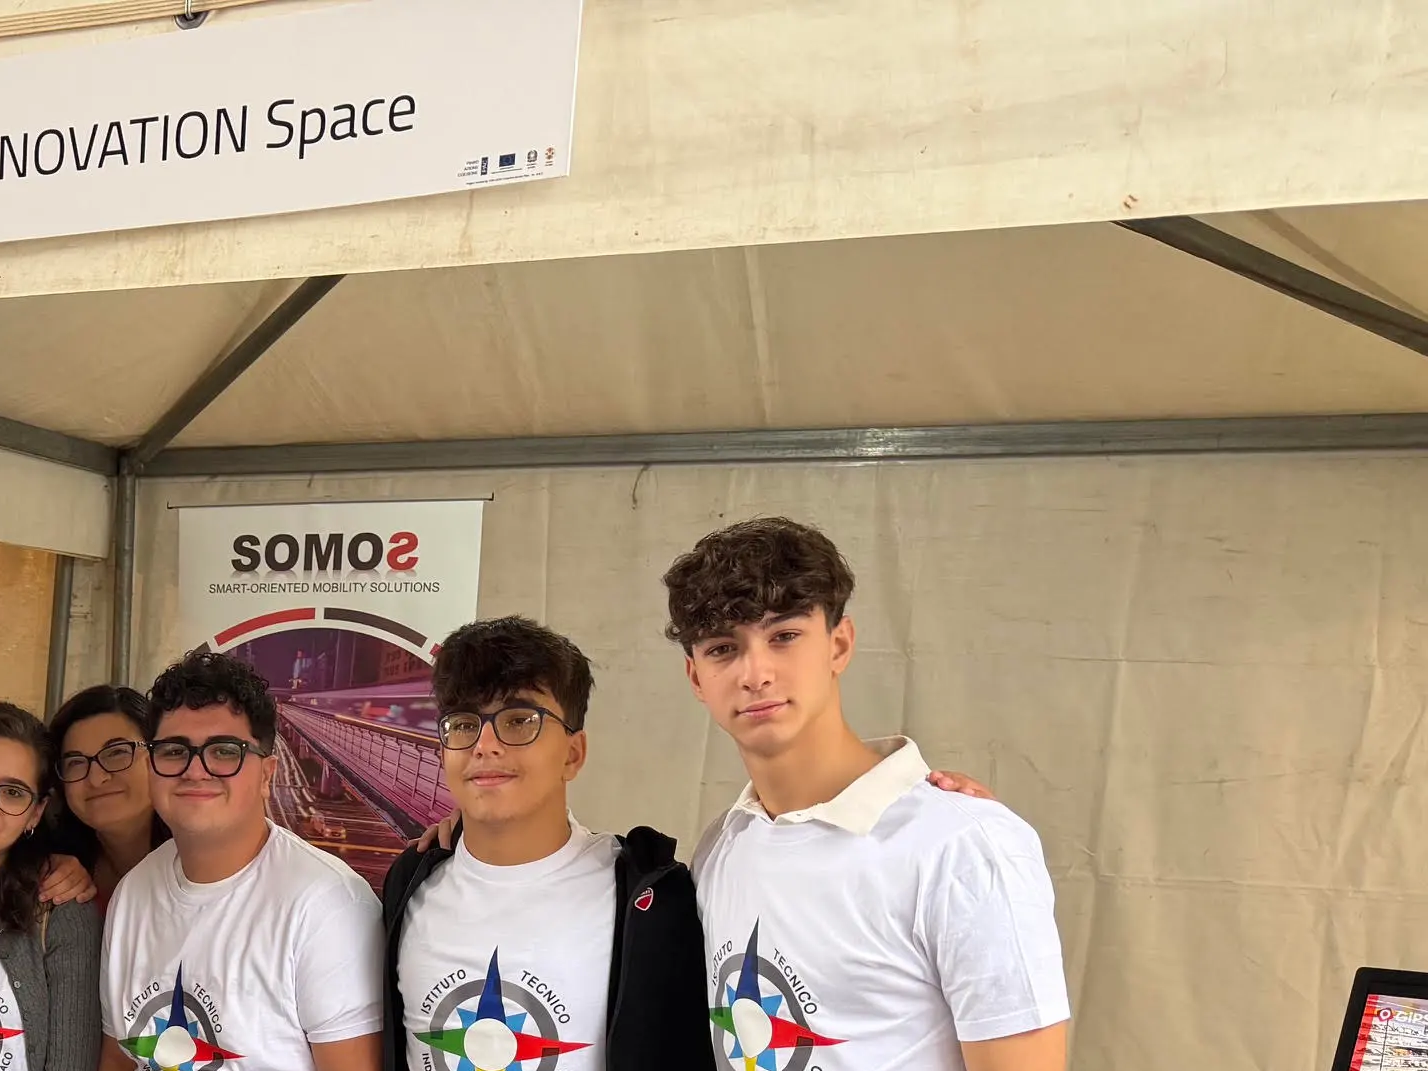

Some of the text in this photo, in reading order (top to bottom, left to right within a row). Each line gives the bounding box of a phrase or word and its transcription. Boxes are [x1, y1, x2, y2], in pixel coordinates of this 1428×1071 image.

[266, 93, 416, 160] Space
[209, 581, 440, 594] SMART-ORIENTED MOBILITY SOLUTIONS
[124, 981, 223, 1034] ISTITUTO TECNICO
[421, 969, 571, 1025] ISTITUTO TECNICO
[773, 948, 818, 1015] TECNICO
